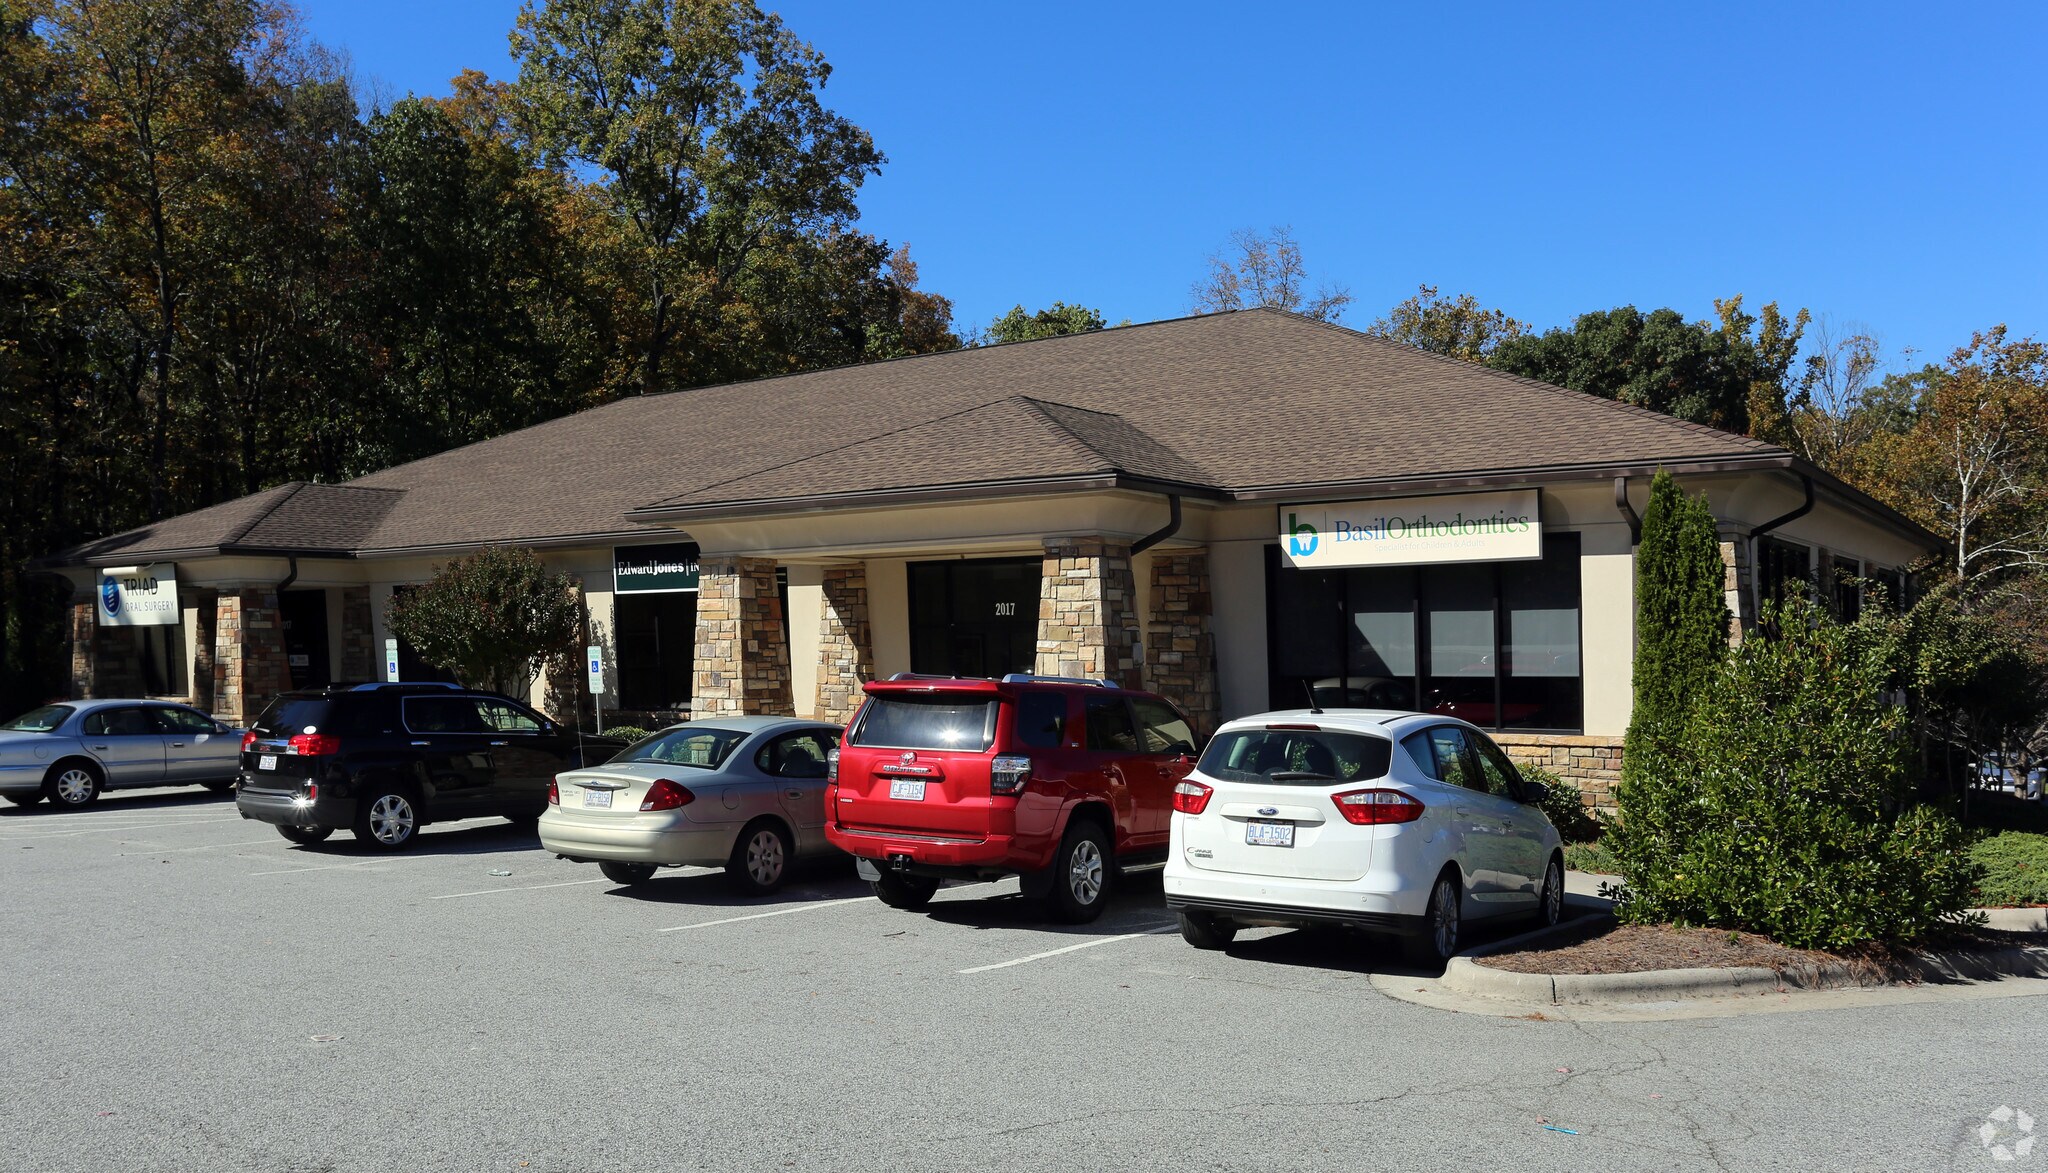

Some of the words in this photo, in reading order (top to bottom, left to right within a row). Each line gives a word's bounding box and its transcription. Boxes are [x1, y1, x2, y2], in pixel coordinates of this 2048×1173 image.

[1335, 510, 1530, 542] BasilOrthodontics
[1374, 542, 1408, 552] Specialist
[1409, 541, 1420, 551] for
[1421, 540, 1453, 550] Children
[1454, 540, 1461, 549] &
[1461, 538, 1486, 548] Adults
[123, 577, 159, 597] TRIAD
[125, 602, 142, 613] ORAL
[144, 600, 175, 612] SURGERY
[995, 602, 1016, 616] 2017
[1249, 825, 1291, 840] BLA-1502
